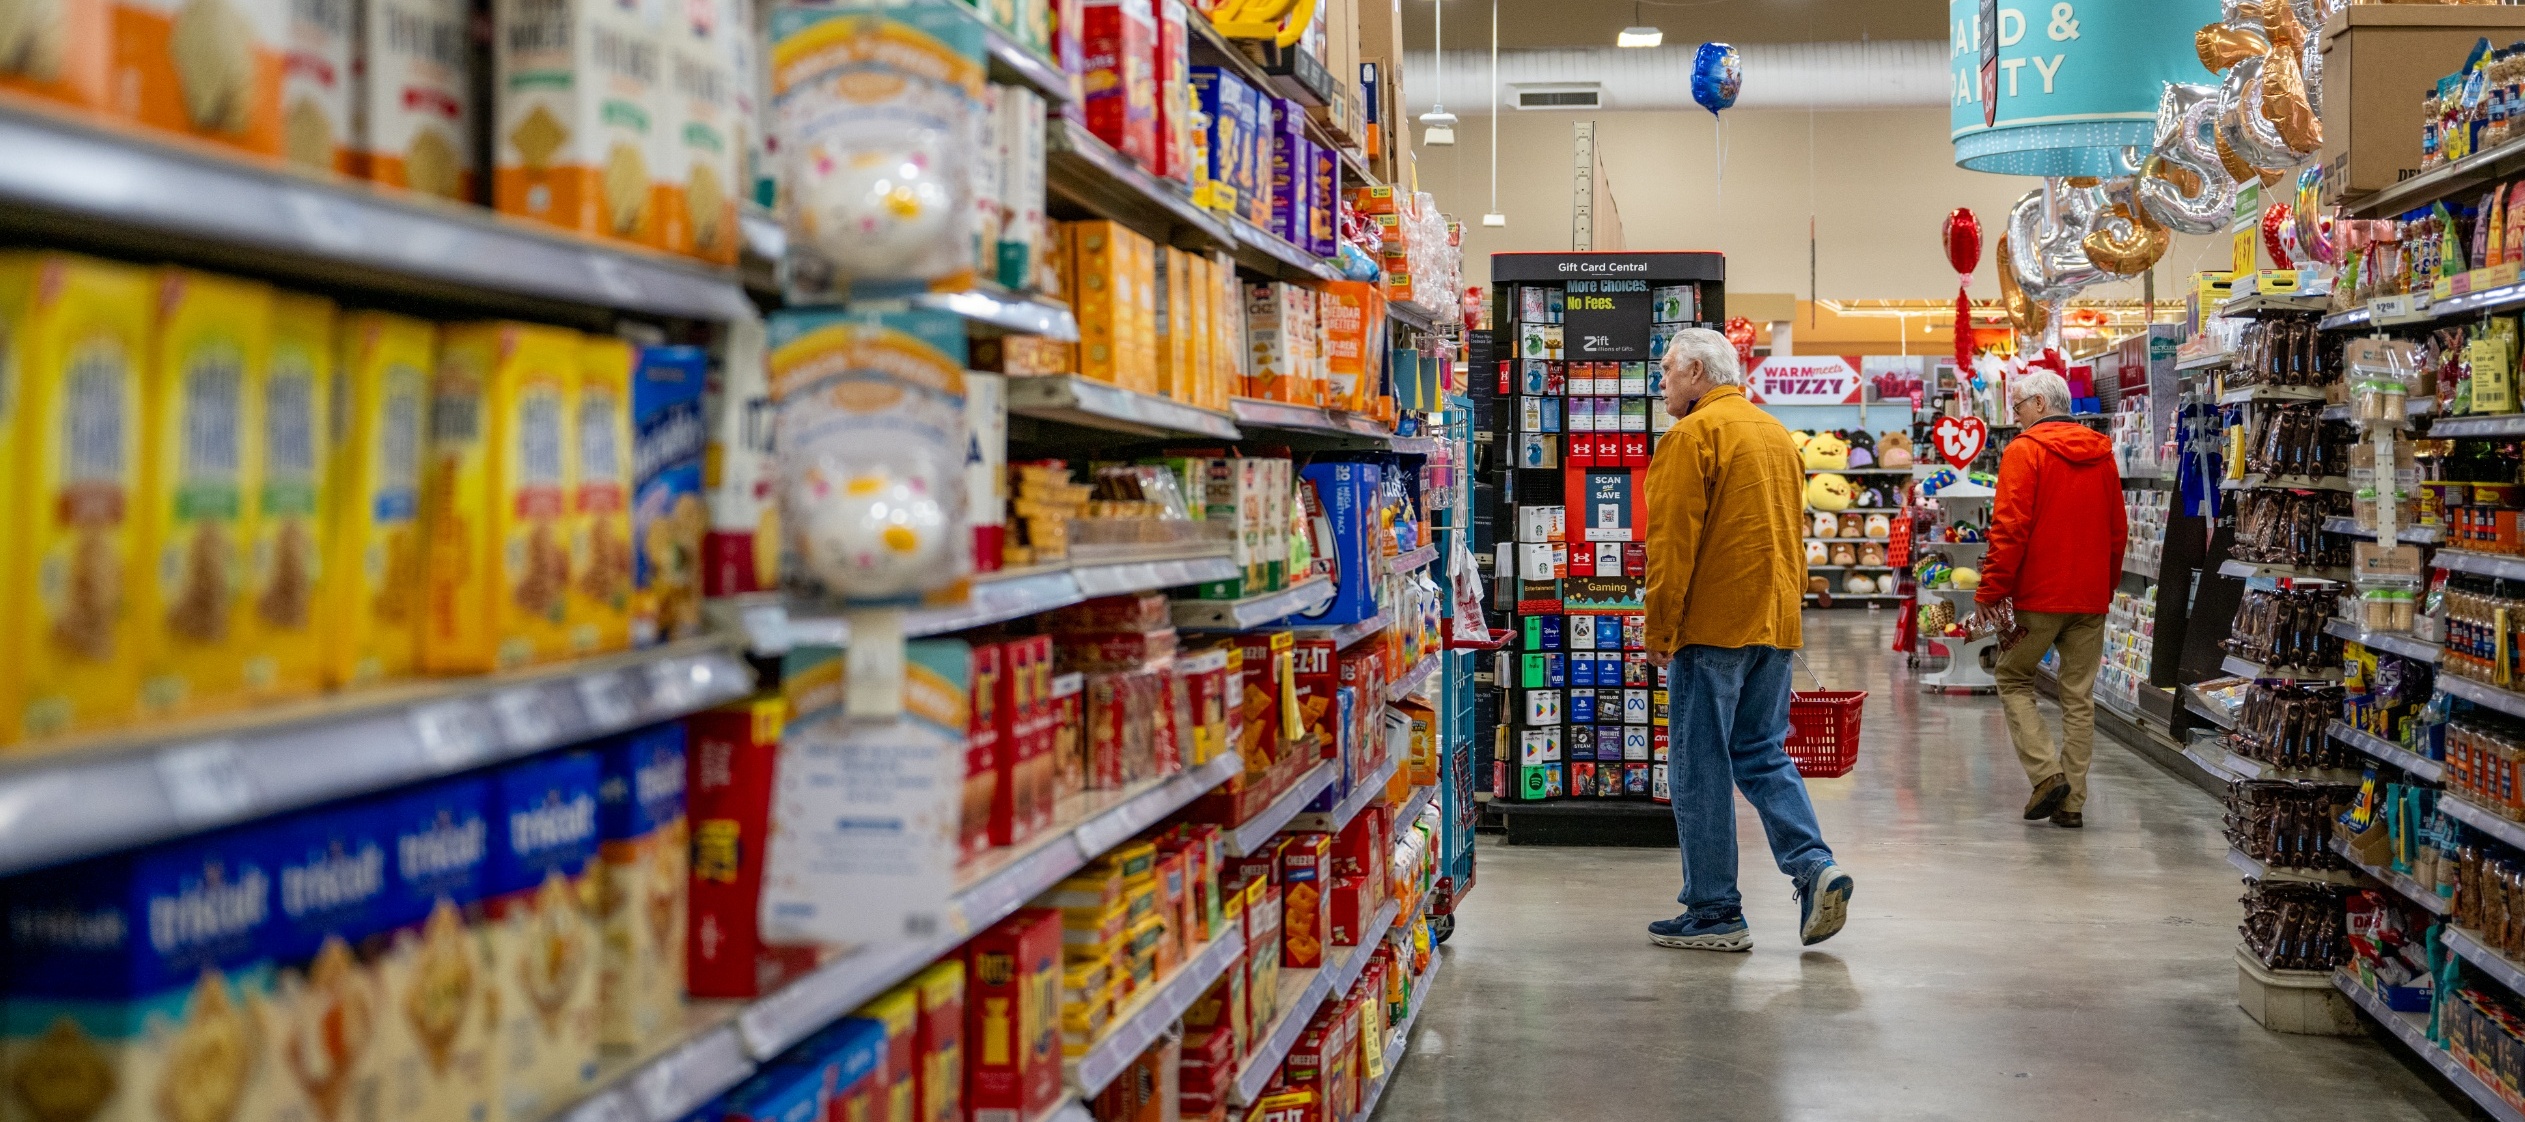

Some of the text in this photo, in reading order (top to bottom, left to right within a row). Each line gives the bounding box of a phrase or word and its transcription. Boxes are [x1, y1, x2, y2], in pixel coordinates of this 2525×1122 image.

[2047, 2, 2080, 42] &
[1558, 262, 1648, 272] Gift Card Central
[1567, 280, 1649, 293] More Choices.
[1567, 296, 1616, 310] No Fees.
[1763, 363, 1844, 377] WARM meets
[1764, 379, 1844, 395] FUZZY
[1937, 420, 1980, 461] ty
[1340, 464, 1351, 481] 30
[1595, 476, 1621, 484] SCAN
[1343, 486, 1352, 509] MEGA
[1337, 515, 1345, 535] PACK
[1588, 583, 1627, 593] Gaming
[1655, 734, 1669, 742] am
